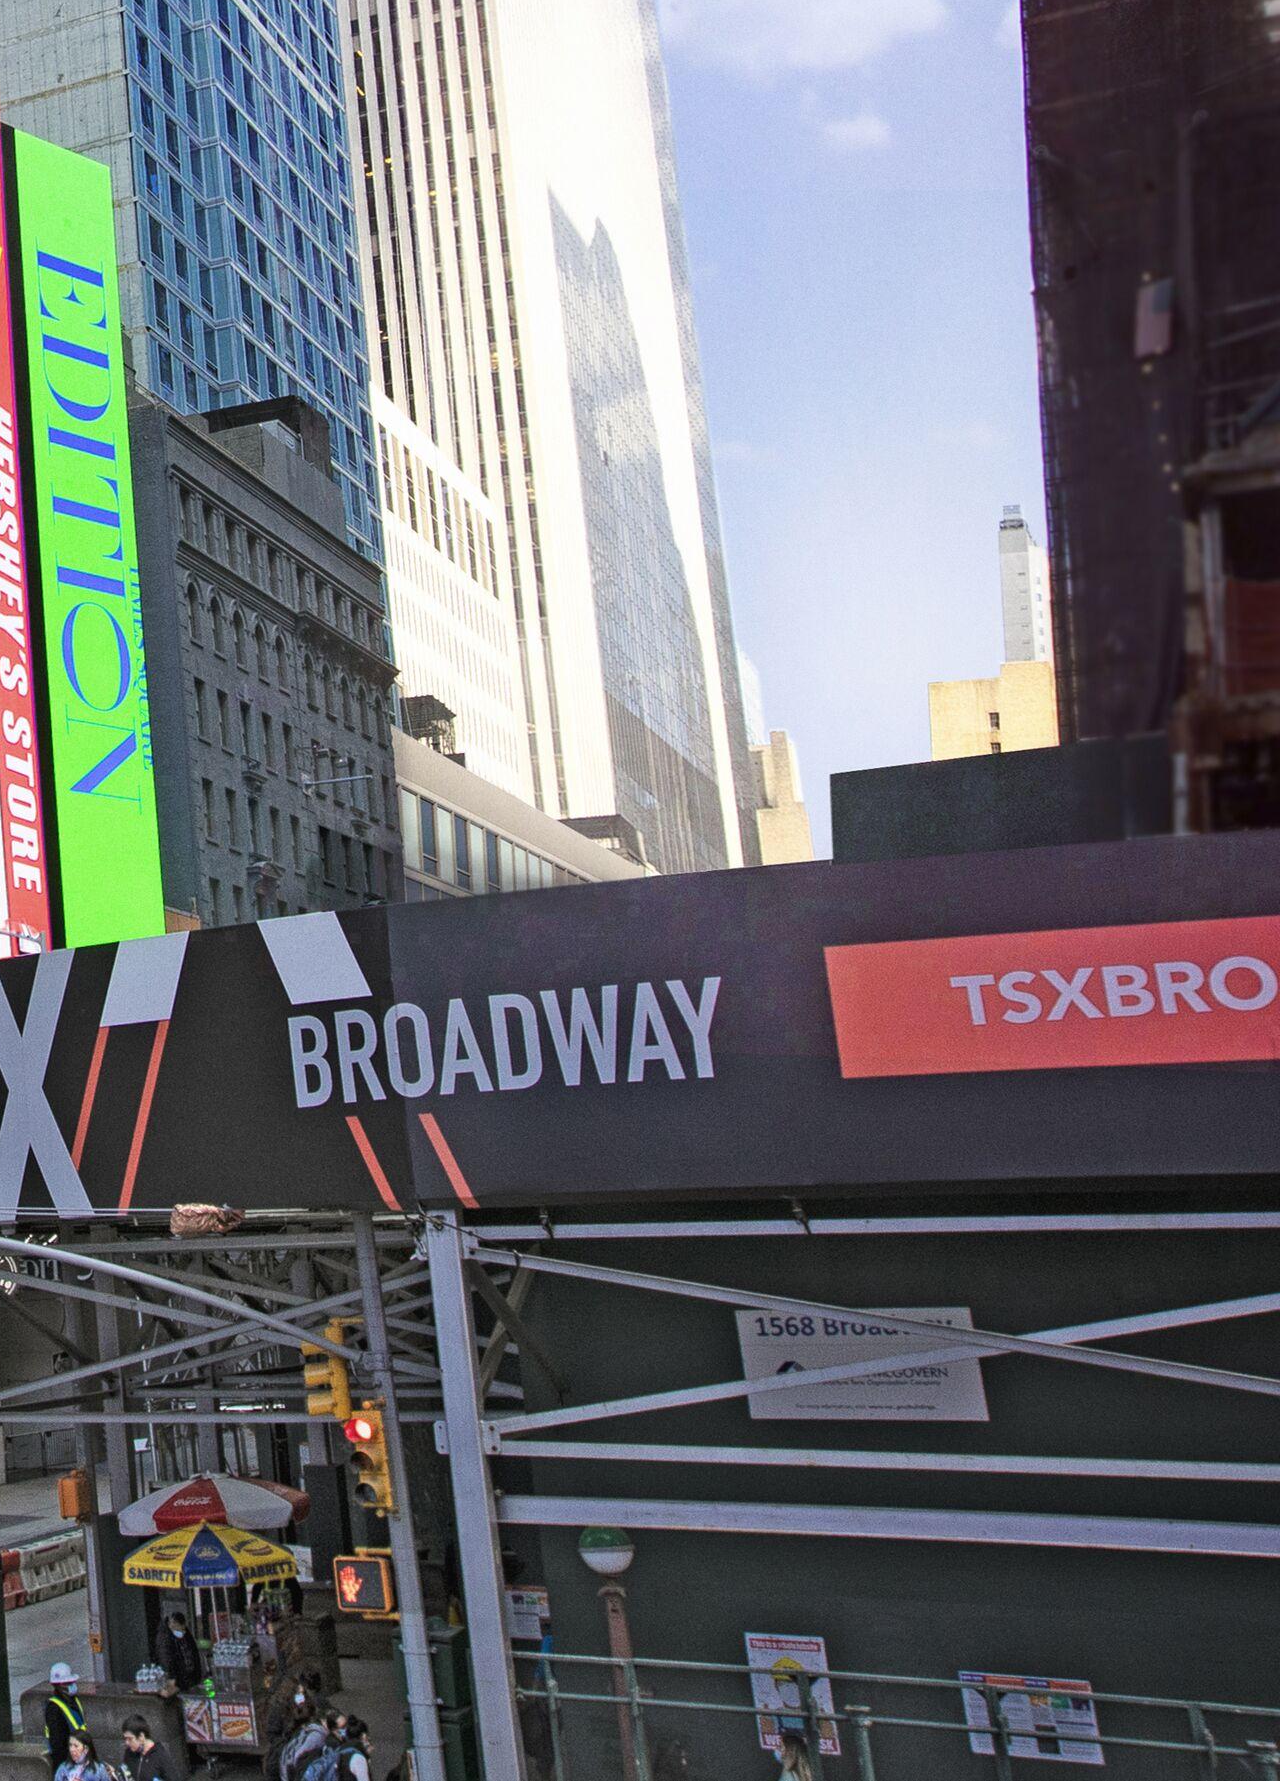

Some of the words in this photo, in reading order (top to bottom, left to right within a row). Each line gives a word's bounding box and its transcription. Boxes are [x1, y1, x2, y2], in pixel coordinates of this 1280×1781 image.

[35, 237, 143, 816] EDITION
[0, 708, 43, 895] STORE
[949, 955, 1279, 1026] TSXBRO
[288, 976, 722, 1110] BROADWAY
[755, 1316, 815, 1337] 1568
[129, 1567, 177, 1583] SABRETT
[243, 1560, 295, 1580] SABRETT
